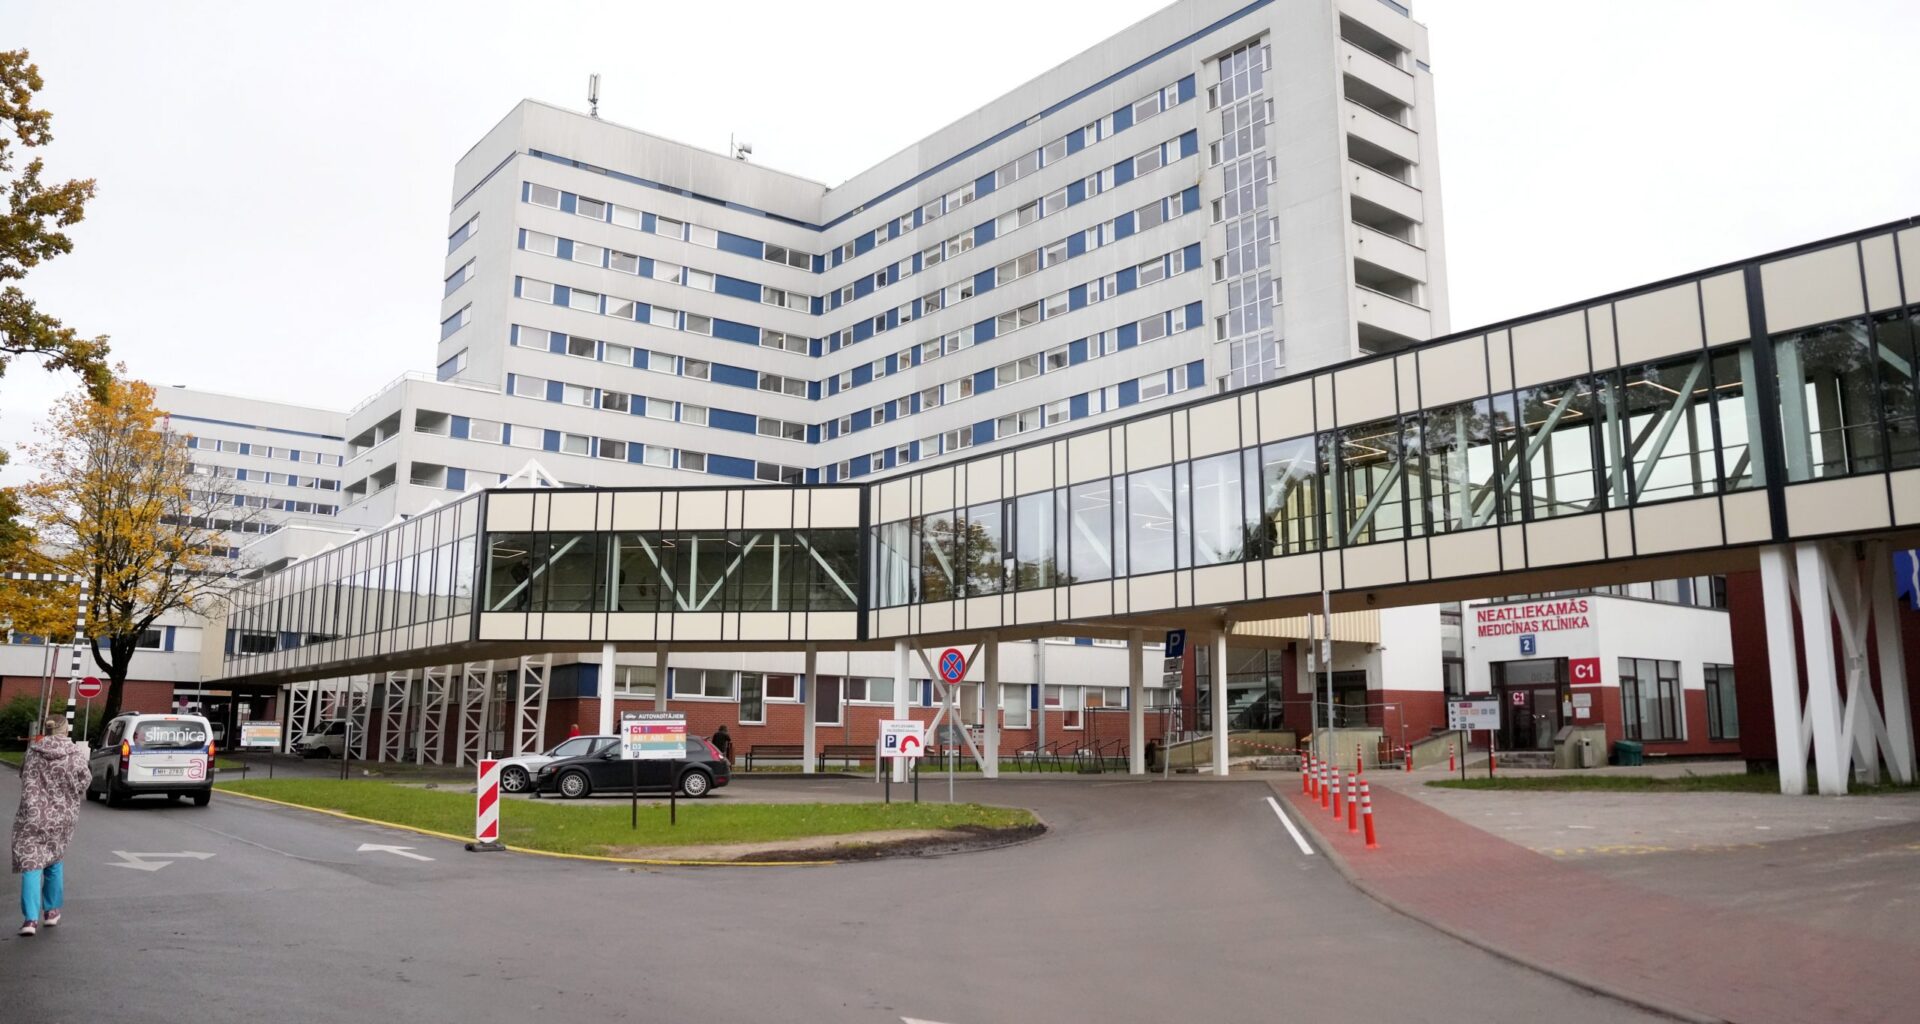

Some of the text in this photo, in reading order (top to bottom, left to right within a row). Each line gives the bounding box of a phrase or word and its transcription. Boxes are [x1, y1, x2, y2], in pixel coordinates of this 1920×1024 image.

[1477, 599, 1588, 622] NEATLIEKAMĀS
[1478, 616, 1589, 637] MEDICĪNAS KLĪNIKA
[1169, 633, 1181, 654] P
[1523, 639, 1531, 651] 2
[1575, 664, 1595, 678] C1
[1512, 692, 1525, 701] C1
[145, 727, 205, 742] slimnica
[887, 735, 895, 747] P
